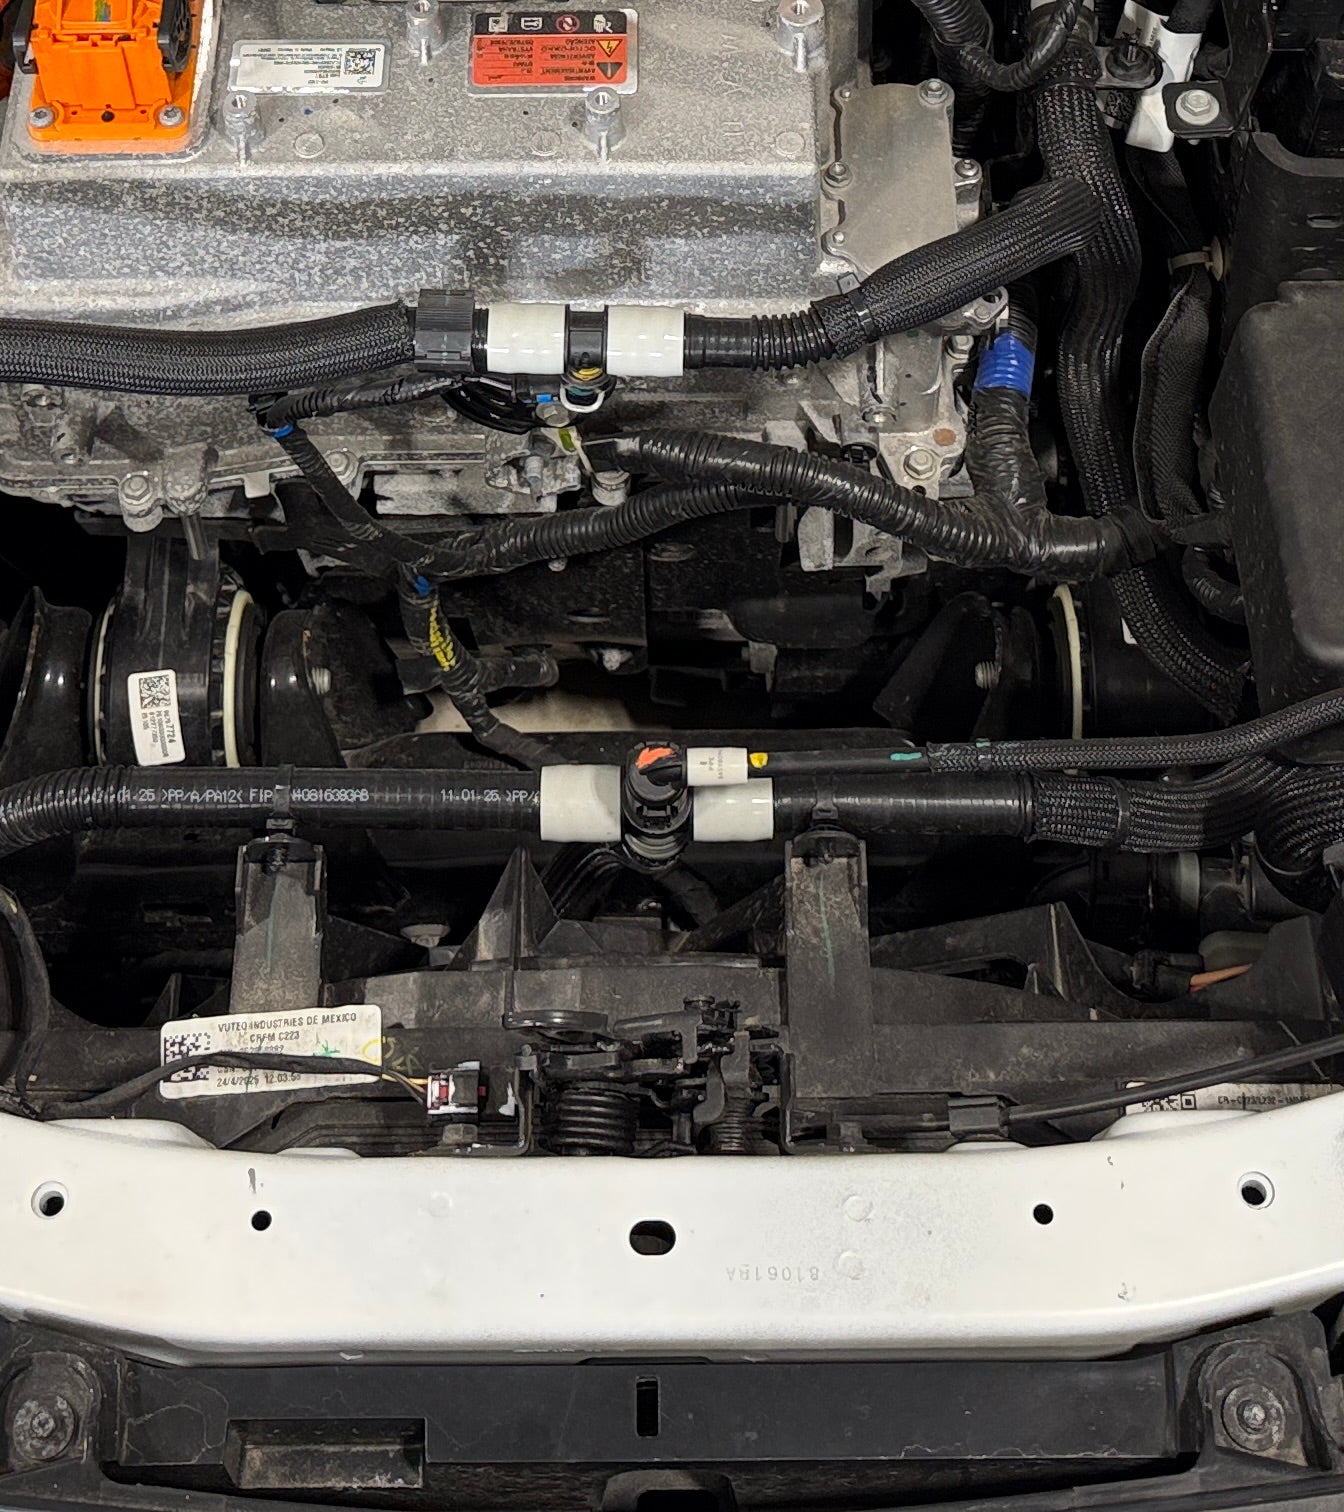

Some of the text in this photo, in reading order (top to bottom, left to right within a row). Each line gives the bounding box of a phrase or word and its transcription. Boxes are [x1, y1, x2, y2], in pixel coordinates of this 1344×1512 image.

[248, 1017, 304, 1031] INDUSTRIES
[306, 1015, 319, 1025] DE
[321, 1012, 357, 1025] MEXICO
[278, 1030, 301, 1042] C223
